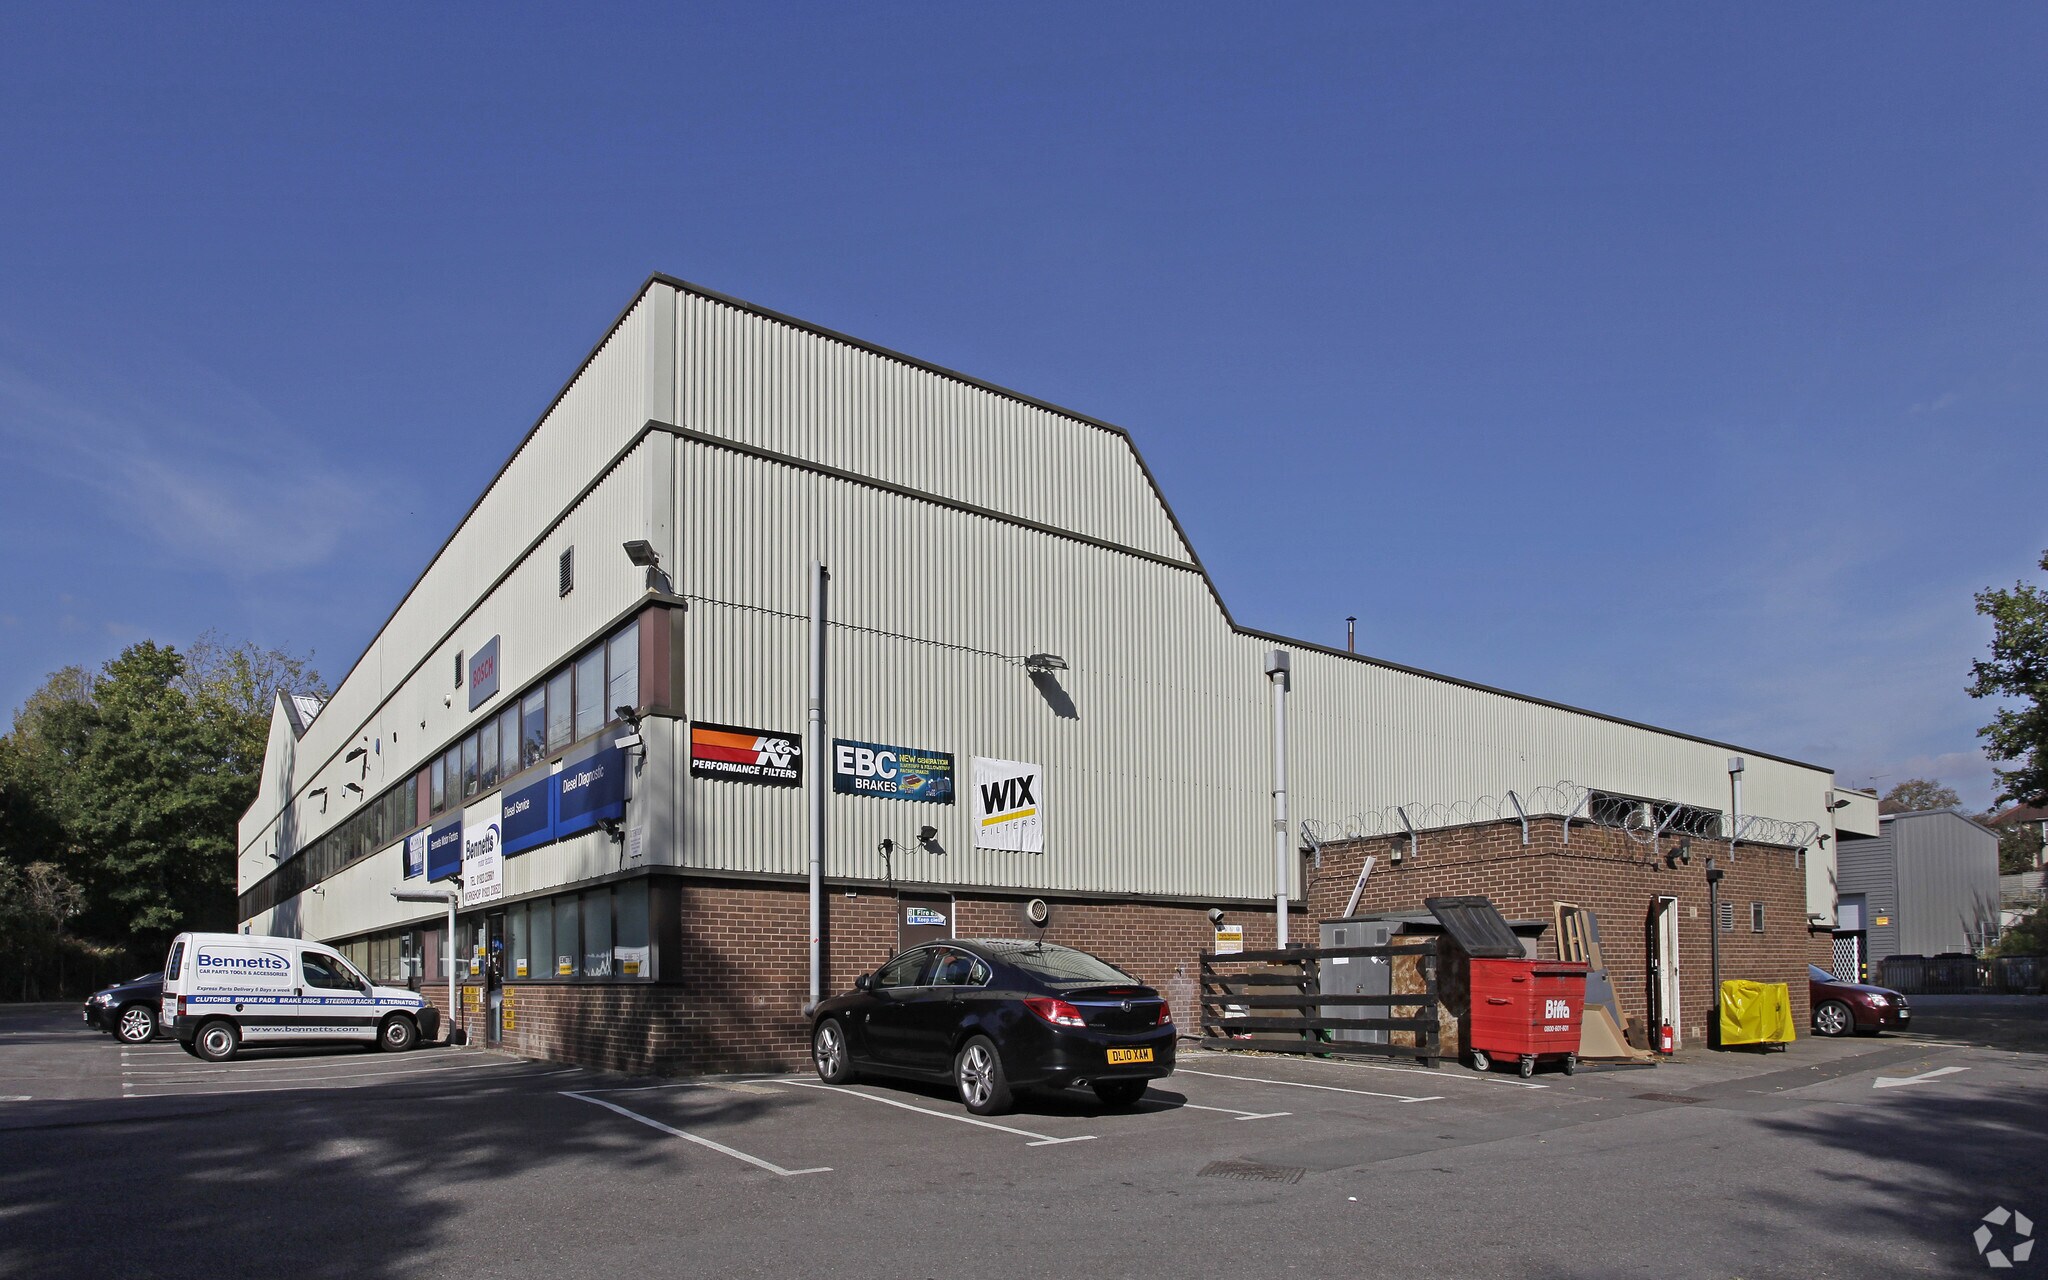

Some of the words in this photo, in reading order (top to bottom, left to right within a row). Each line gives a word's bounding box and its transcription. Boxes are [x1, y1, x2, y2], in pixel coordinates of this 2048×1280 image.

[472, 655, 494, 689] BOSCH
[692, 759, 761, 775] PERFORMANCE
[762, 767, 797, 779] FILTERS
[837, 745, 897, 779] EBC
[899, 754, 916, 764] NEW
[917, 757, 949, 766] GENERATION
[563, 775, 578, 793] Diesel
[578, 764, 605, 787] Diagnostic
[855, 778, 897, 793] BRAKES
[981, 774, 1036, 815] WIX
[504, 803, 515, 818] Diesel
[516, 798, 530, 814] Service
[981, 818, 1036, 837] FILTERS
[431, 839, 442, 851] Bennetts
[449, 832, 459, 844] Factors
[465, 832, 494, 861] Bennetts
[198, 954, 282, 970] Bennetts
[1545, 999, 1570, 1019] Biffa
[1112, 1050, 1132, 1061] DL10
[1134, 1049, 1149, 1060] XAM
